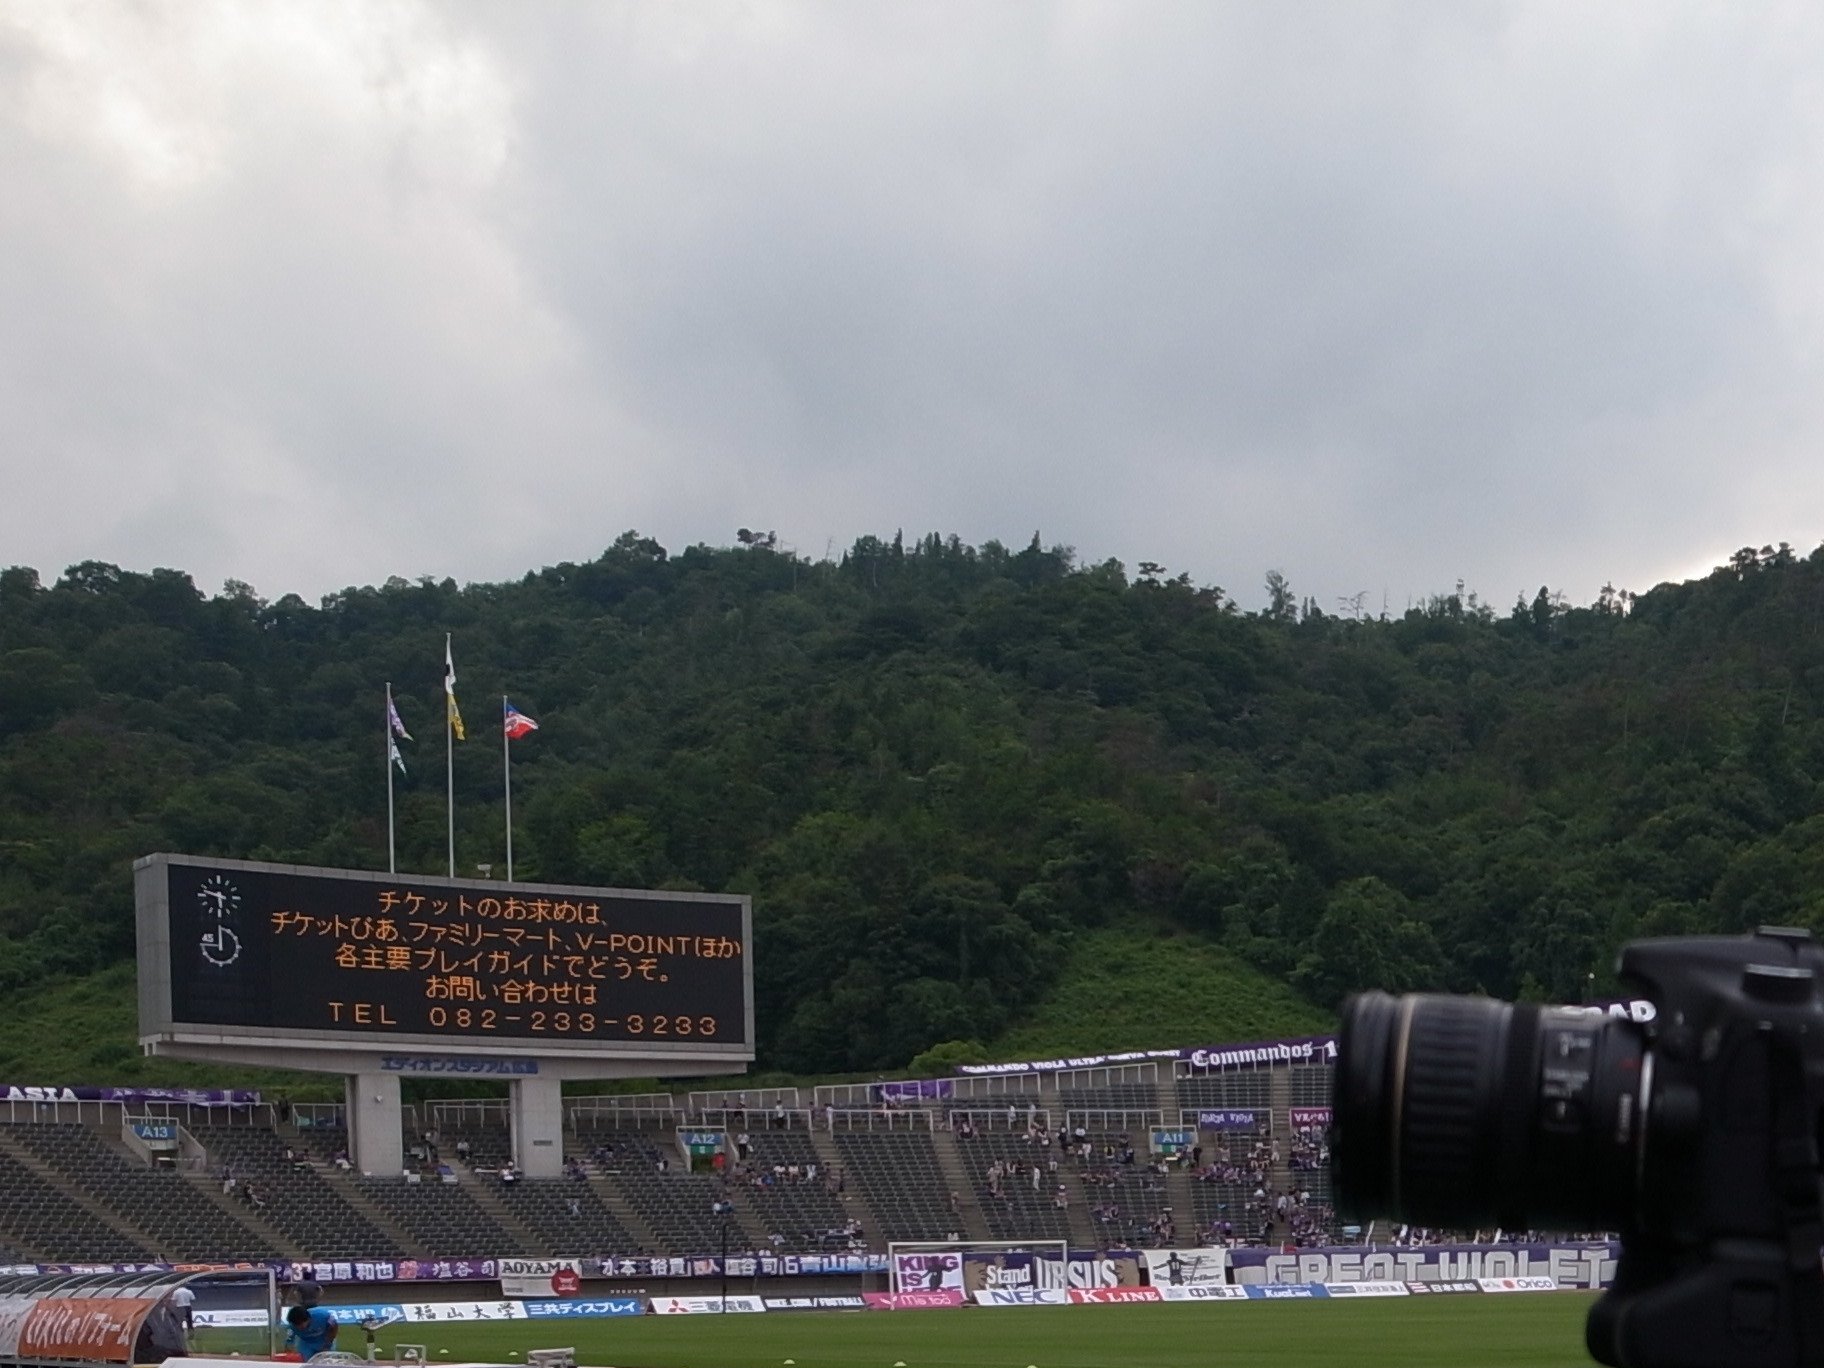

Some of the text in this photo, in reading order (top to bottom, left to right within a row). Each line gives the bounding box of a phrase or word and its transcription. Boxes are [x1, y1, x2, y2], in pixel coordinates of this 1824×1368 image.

[379, 891, 608, 926] チケットのお求めは、
[335, 942, 669, 982] 各主要プレイガイドでどうぞ。
[425, 974, 598, 1005] お問い合わせは
[329, 1002, 397, 1025] TEL
[1191, 1041, 1314, 1067] Commandos
[141, 1125, 169, 1139] A13
[690, 1133, 715, 1144] A12
[1162, 1132, 1183, 1143] A11
[502, 1261, 574, 1274] AOYAMA
[902, 1272, 922, 1287] IS
[986, 1264, 1031, 1286] Stand
[1517, 1279, 1552, 1288] Orico
[991, 1290, 1058, 1304] NEC
[1106, 1290, 1156, 1302] LINE
